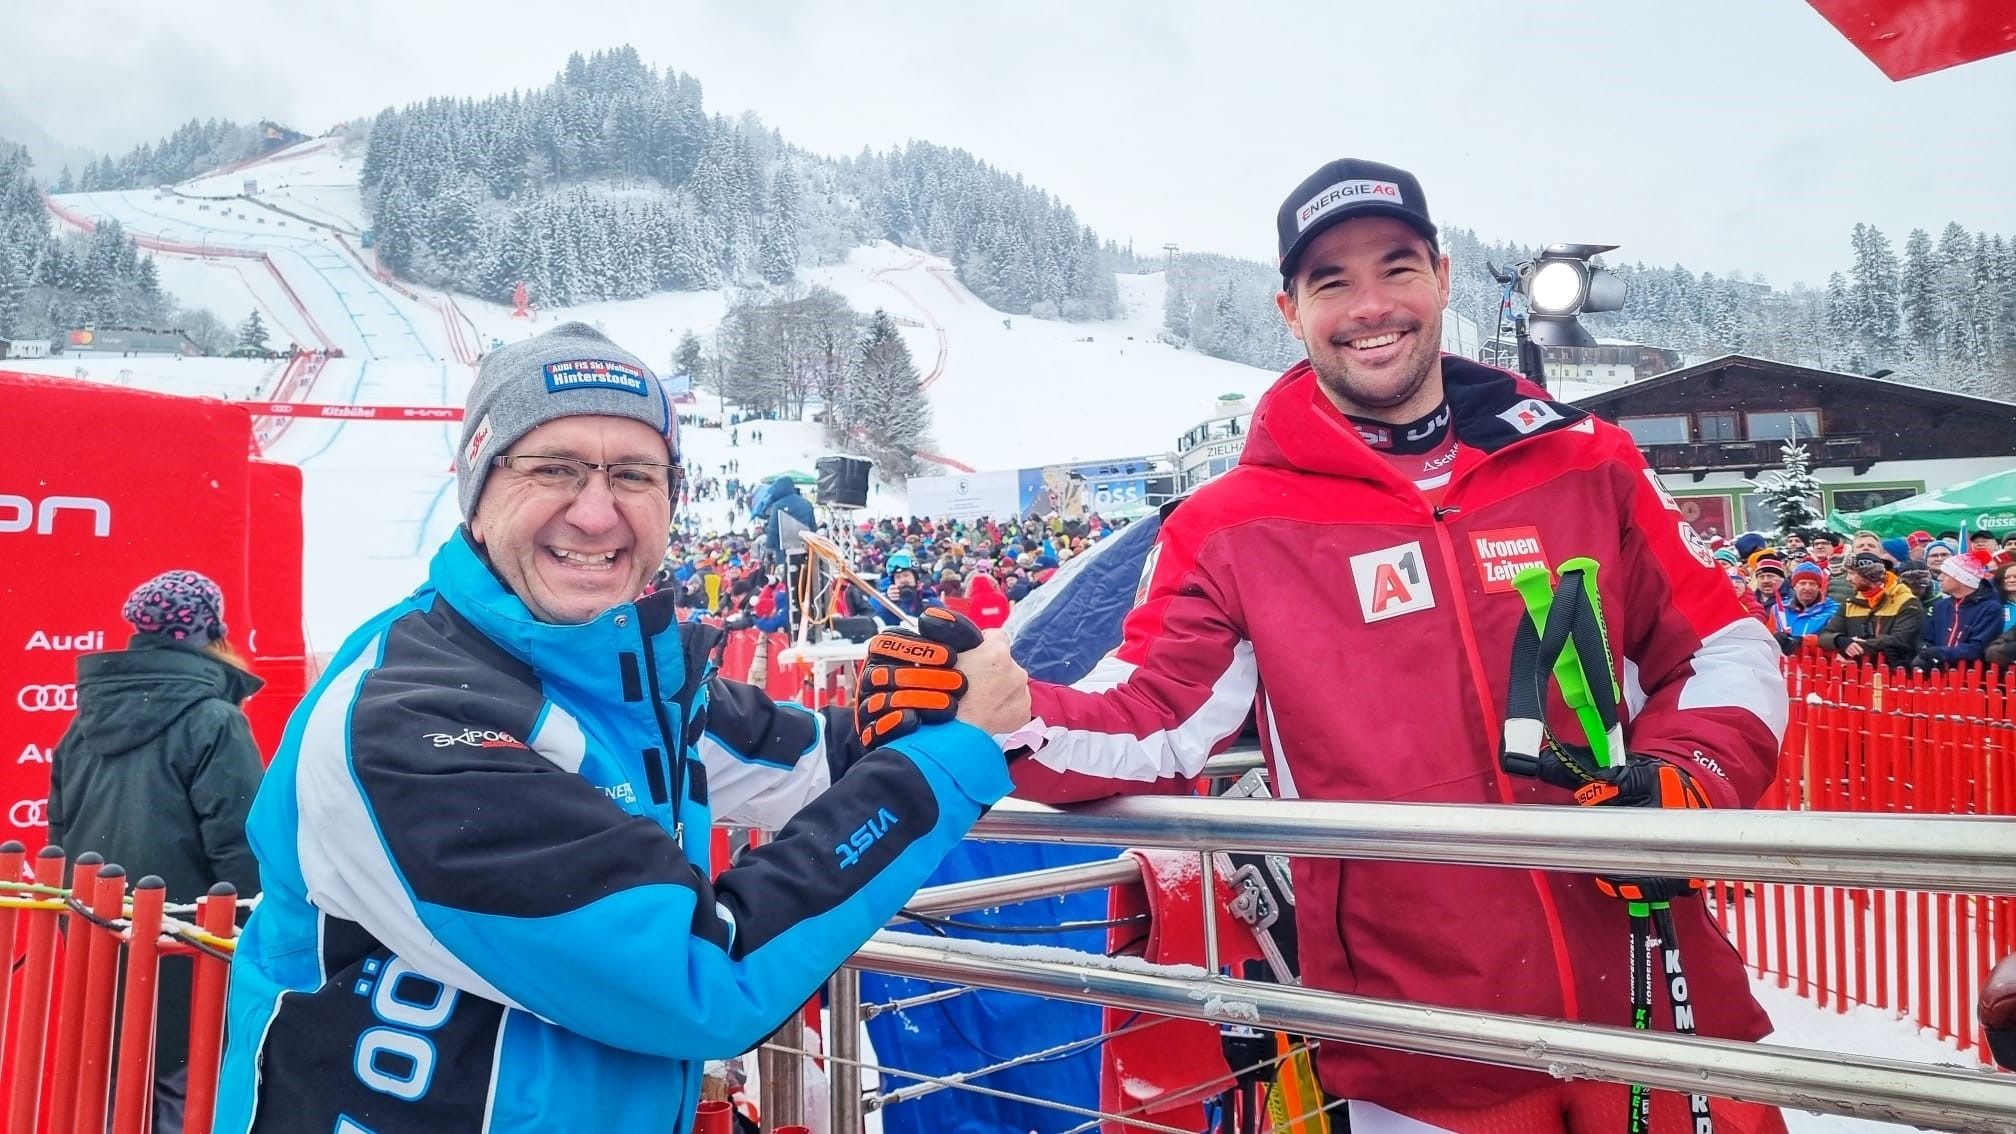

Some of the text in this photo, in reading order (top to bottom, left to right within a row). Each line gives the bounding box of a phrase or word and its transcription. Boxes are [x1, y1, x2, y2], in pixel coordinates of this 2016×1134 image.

[574, 361, 589, 370] FIS
[590, 361, 605, 369] Ski
[553, 371, 641, 388] Hinterstoder
[321, 407, 452, 417] Kitzbühel e-tron
[1518, 401, 1547, 427] A1
[1476, 538, 1540, 559] Kronen
[1371, 551, 1420, 613] A1
[24, 630, 104, 651] Audi
